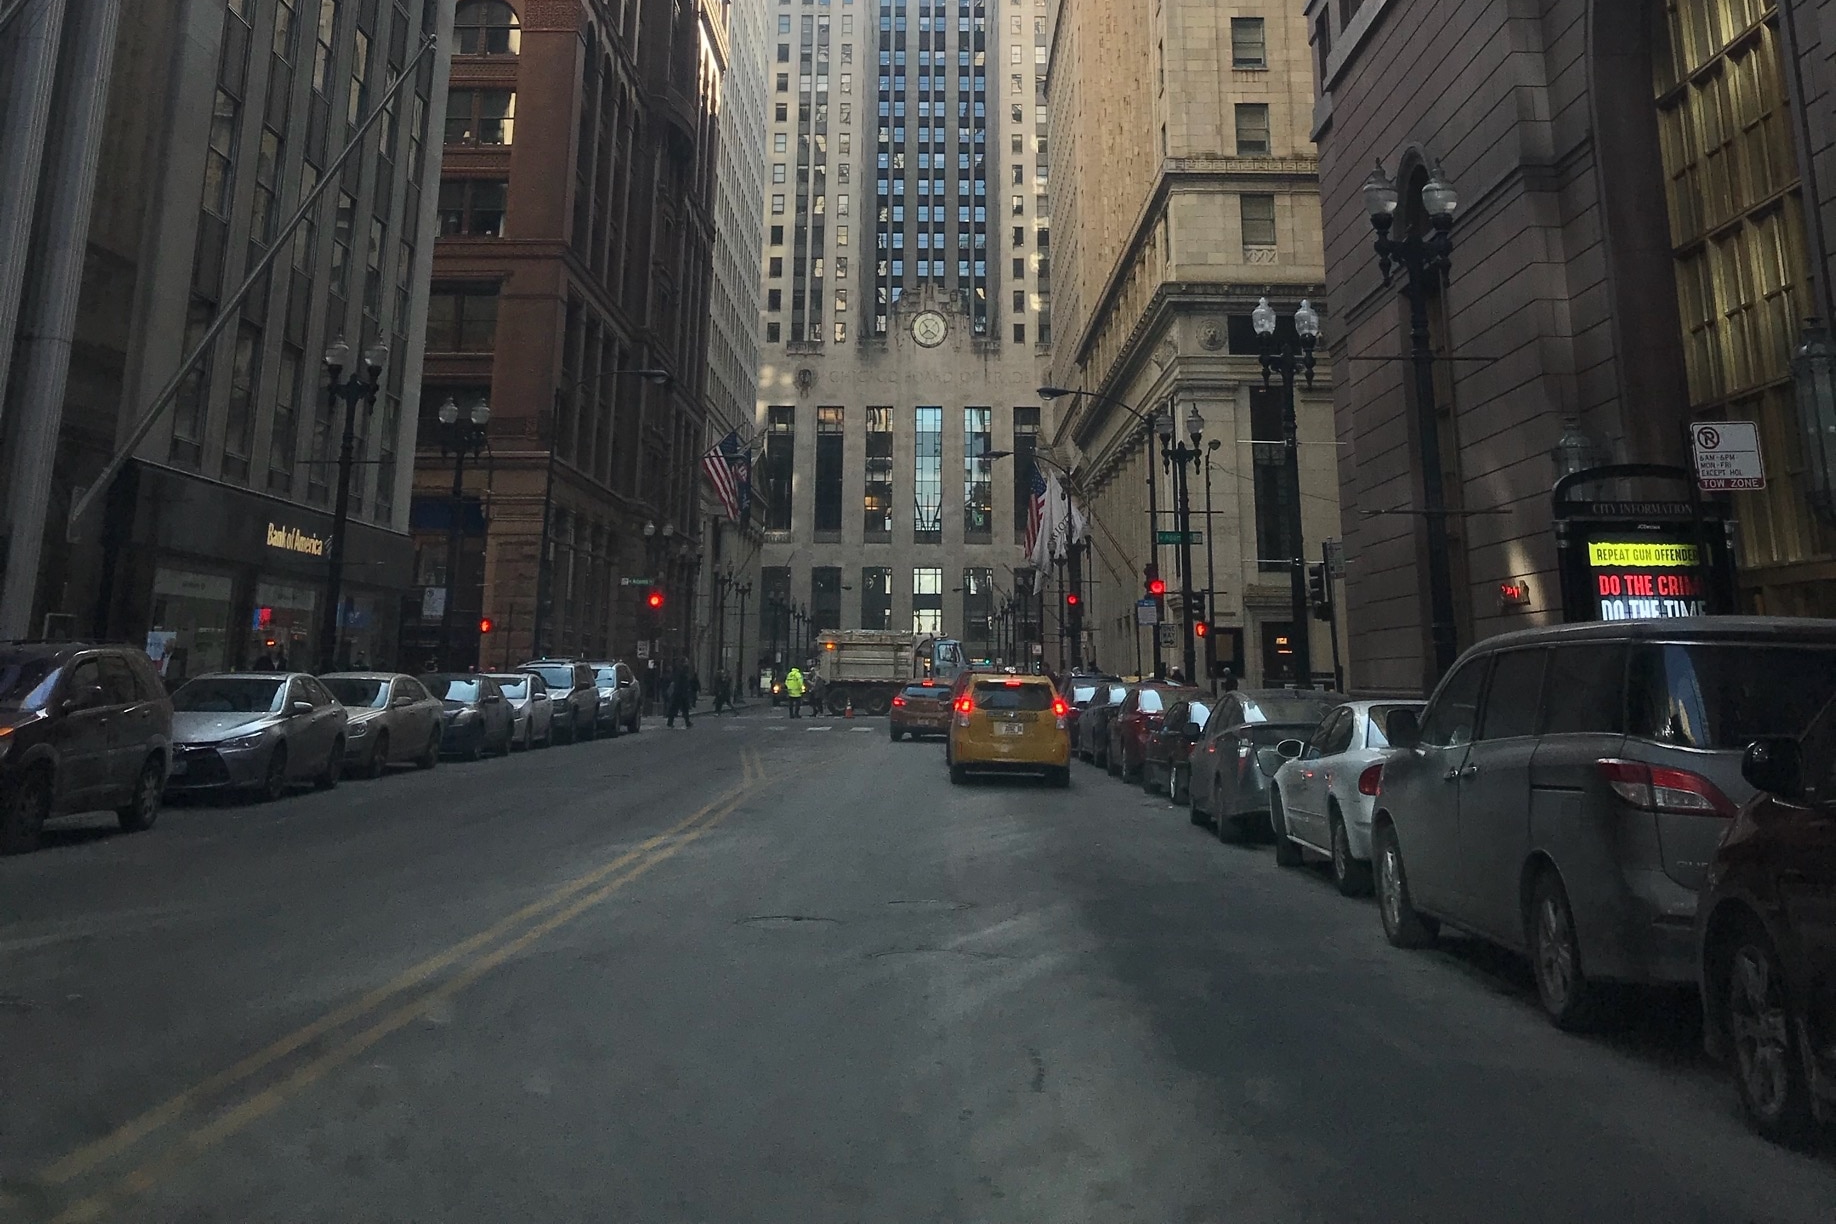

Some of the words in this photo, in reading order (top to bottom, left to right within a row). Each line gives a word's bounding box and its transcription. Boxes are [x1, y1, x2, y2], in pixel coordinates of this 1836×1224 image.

[1701, 469, 1726, 477] EXCEPT
[1703, 479, 1725, 488] TOW
[1730, 478, 1760, 488] ZONE
[1592, 503, 1617, 514] CITY
[1619, 503, 1693, 514] INFORMATION
[266, 522, 286, 548] Bank
[286, 527, 296, 550] of
[294, 529, 323, 556] America
[1596, 548, 1629, 562] REPEAT
[1632, 548, 1652, 562] GUN
[1654, 548, 1699, 563] OFFENDER
[1598, 574, 1621, 596] DO
[1623, 574, 1654, 596] THE
[1657, 574, 1703, 597] CRIM
[1601, 599, 1626, 621] DO
[1628, 599, 1660, 620] THE
[1663, 599, 1706, 619] TIME
